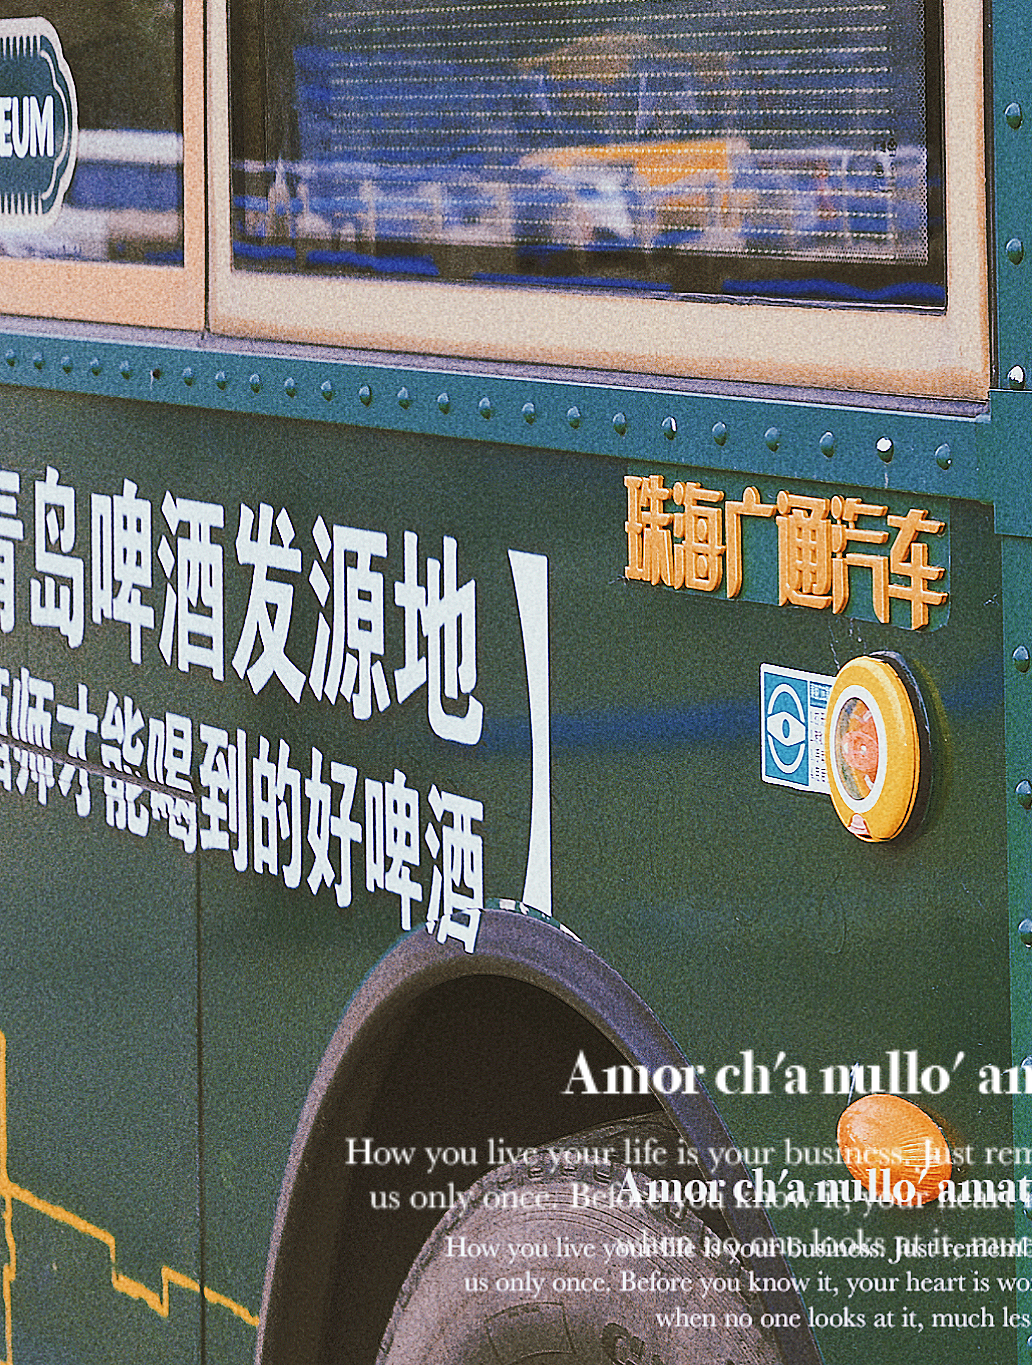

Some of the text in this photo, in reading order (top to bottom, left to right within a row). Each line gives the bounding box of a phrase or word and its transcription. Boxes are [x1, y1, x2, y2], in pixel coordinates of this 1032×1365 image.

[624, 474, 949, 630] 珠海广通汽车
